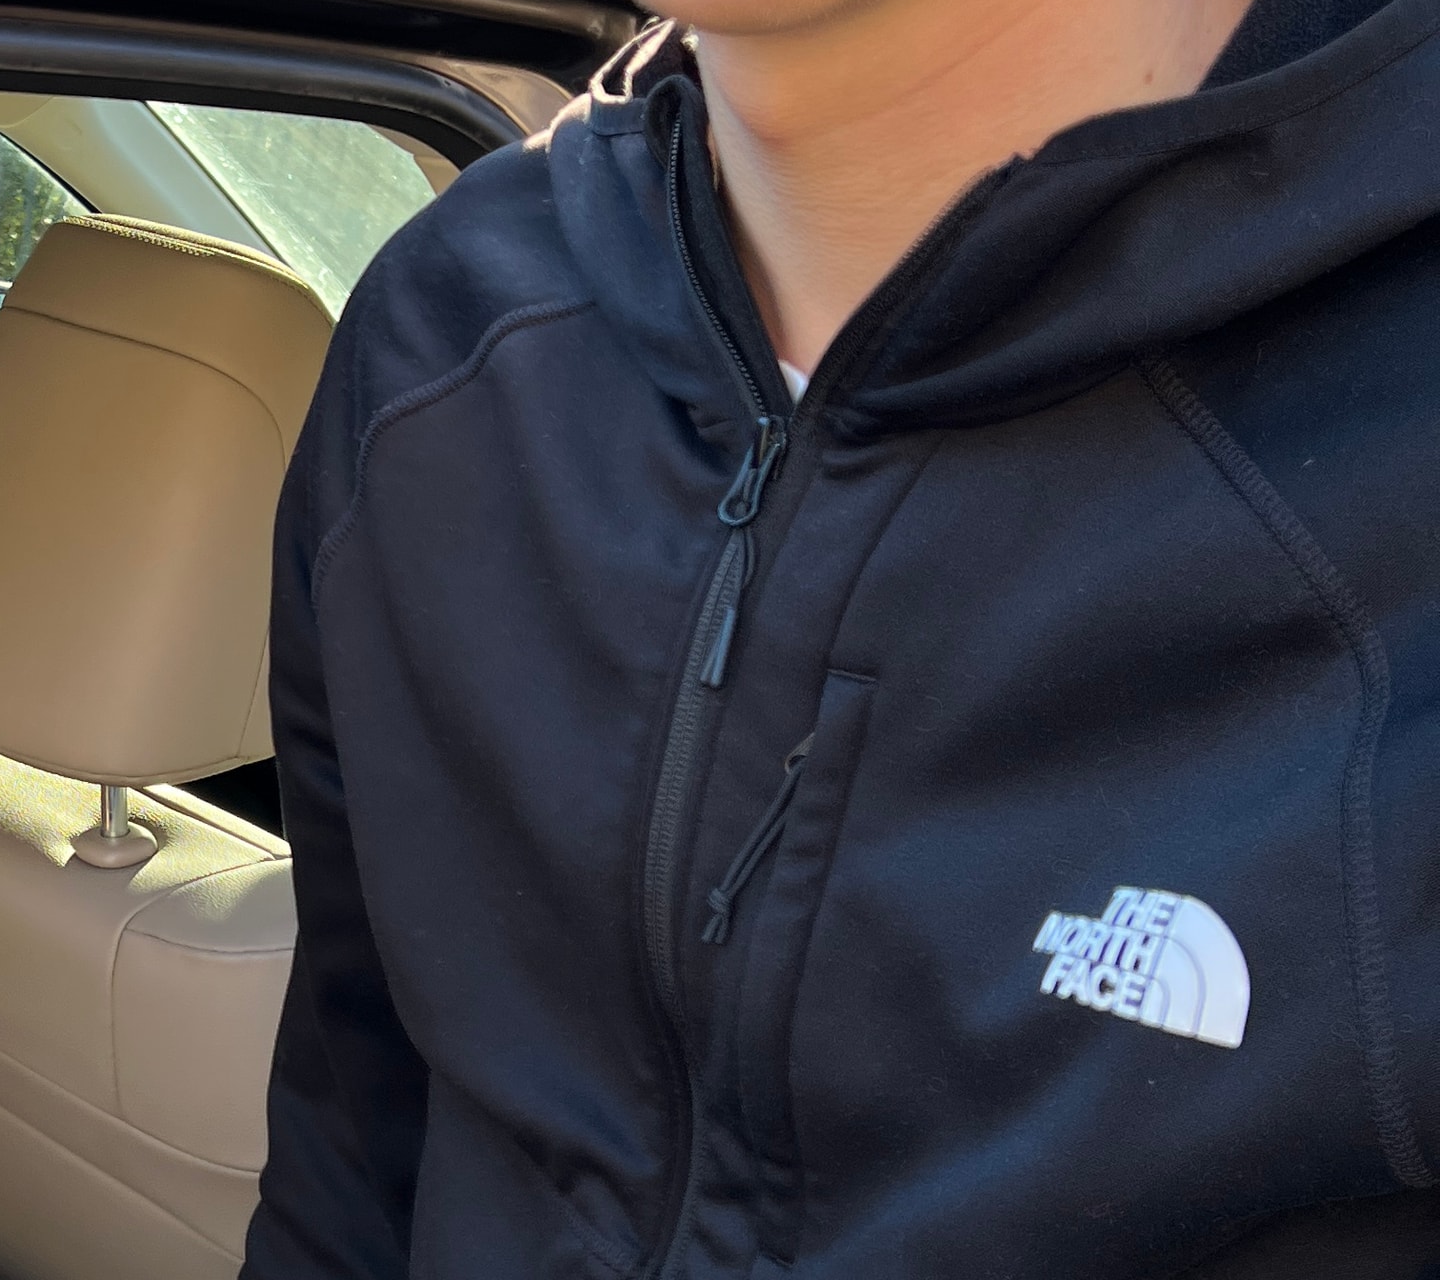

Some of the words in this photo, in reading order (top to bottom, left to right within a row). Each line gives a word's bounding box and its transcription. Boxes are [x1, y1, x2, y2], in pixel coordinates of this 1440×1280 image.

[1101, 886, 1176, 933] THE
[1033, 911, 1162, 973] NORTH
[1040, 952, 1147, 1020] FACE
